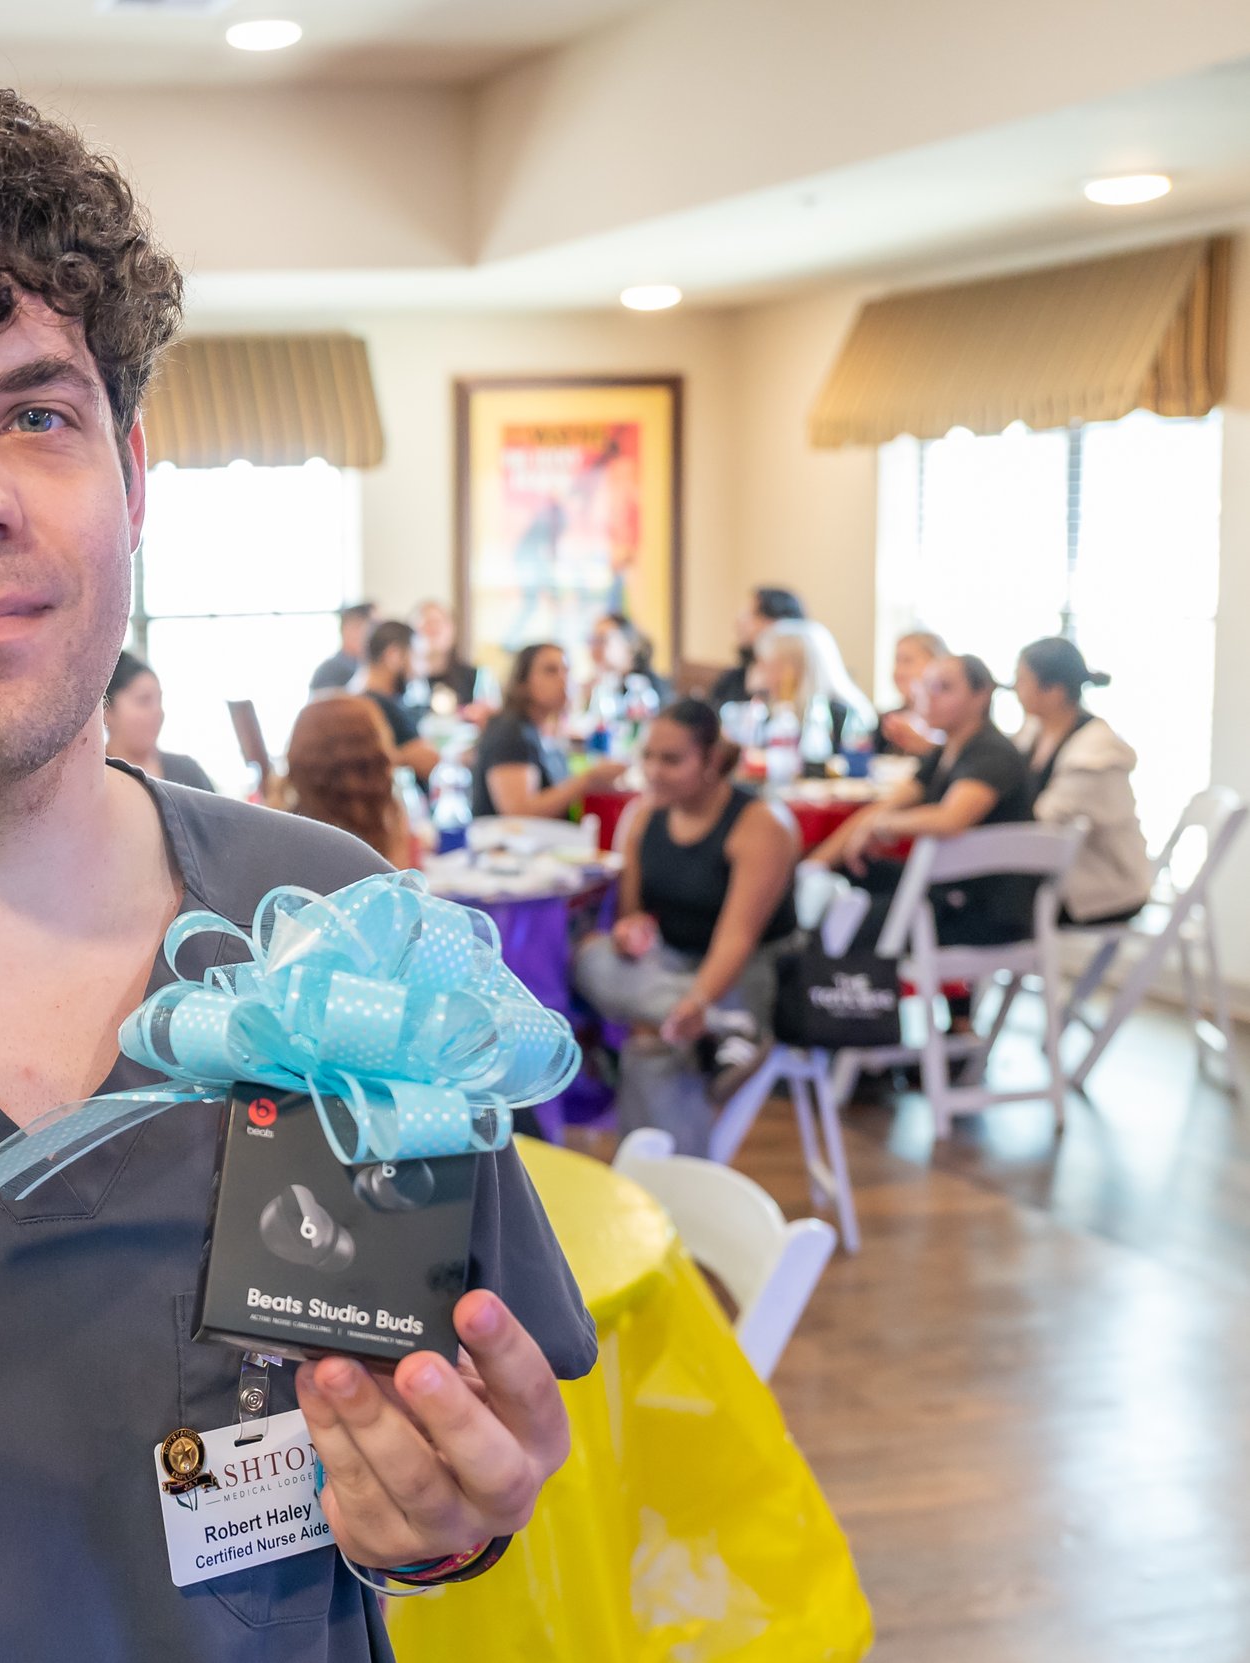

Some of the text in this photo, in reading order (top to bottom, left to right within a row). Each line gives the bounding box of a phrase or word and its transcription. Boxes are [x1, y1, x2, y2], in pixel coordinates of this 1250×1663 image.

[247, 1125, 274, 1139] beats
[247, 1288, 424, 1335] Beats Studio Buds
[223, 1472, 313, 1502] MEDICAL LODGE
[205, 1503, 312, 1543] Robert Haley
[195, 1522, 330, 1569] Certified Nurse Aide
